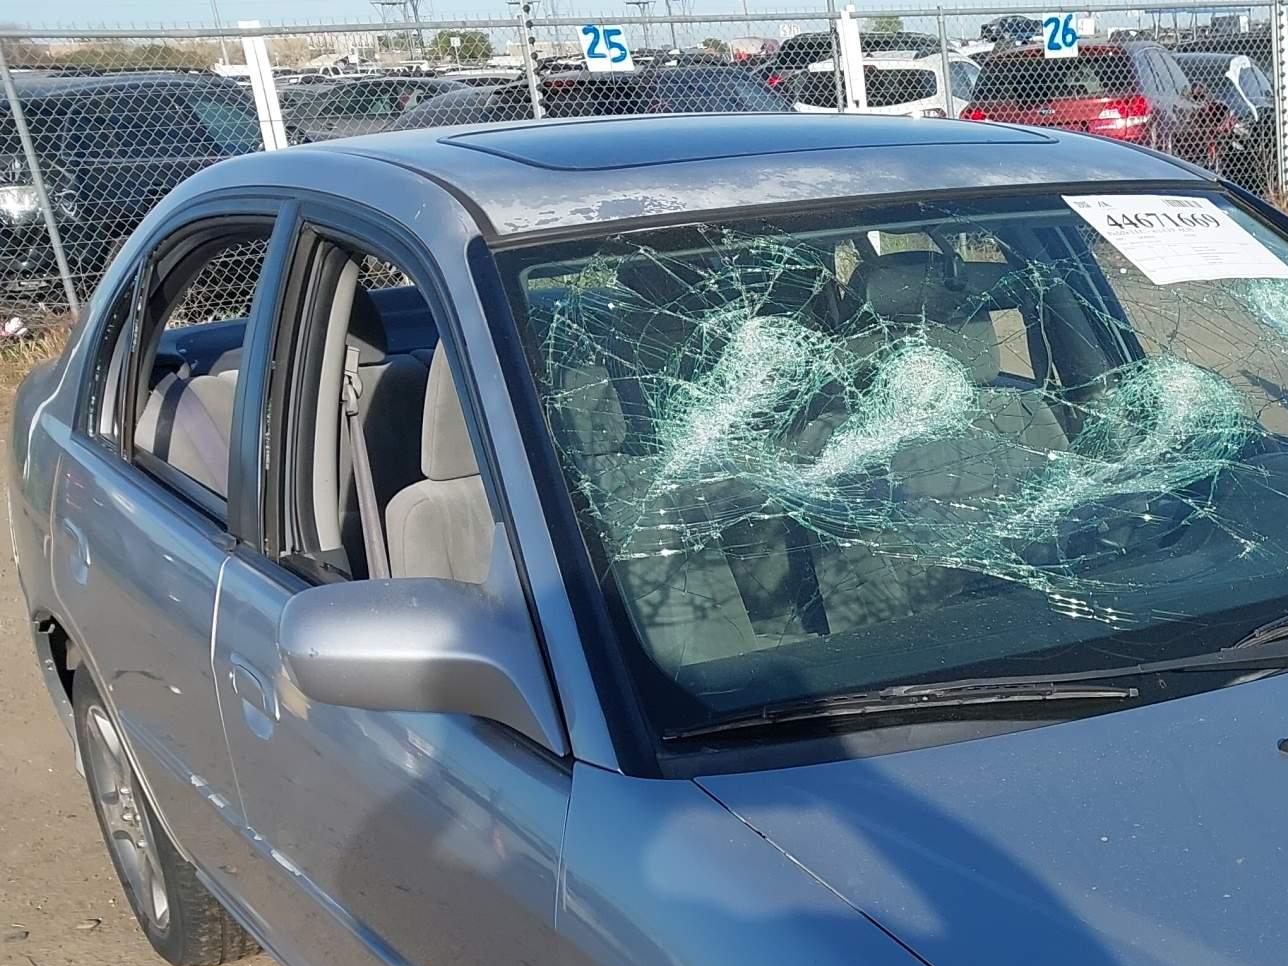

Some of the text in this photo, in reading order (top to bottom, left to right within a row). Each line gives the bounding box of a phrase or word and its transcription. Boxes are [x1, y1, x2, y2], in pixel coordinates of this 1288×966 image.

[582, 24, 627, 63] 25
[1043, 14, 1080, 50] 26
[1106, 213, 1221, 229] 44671669
